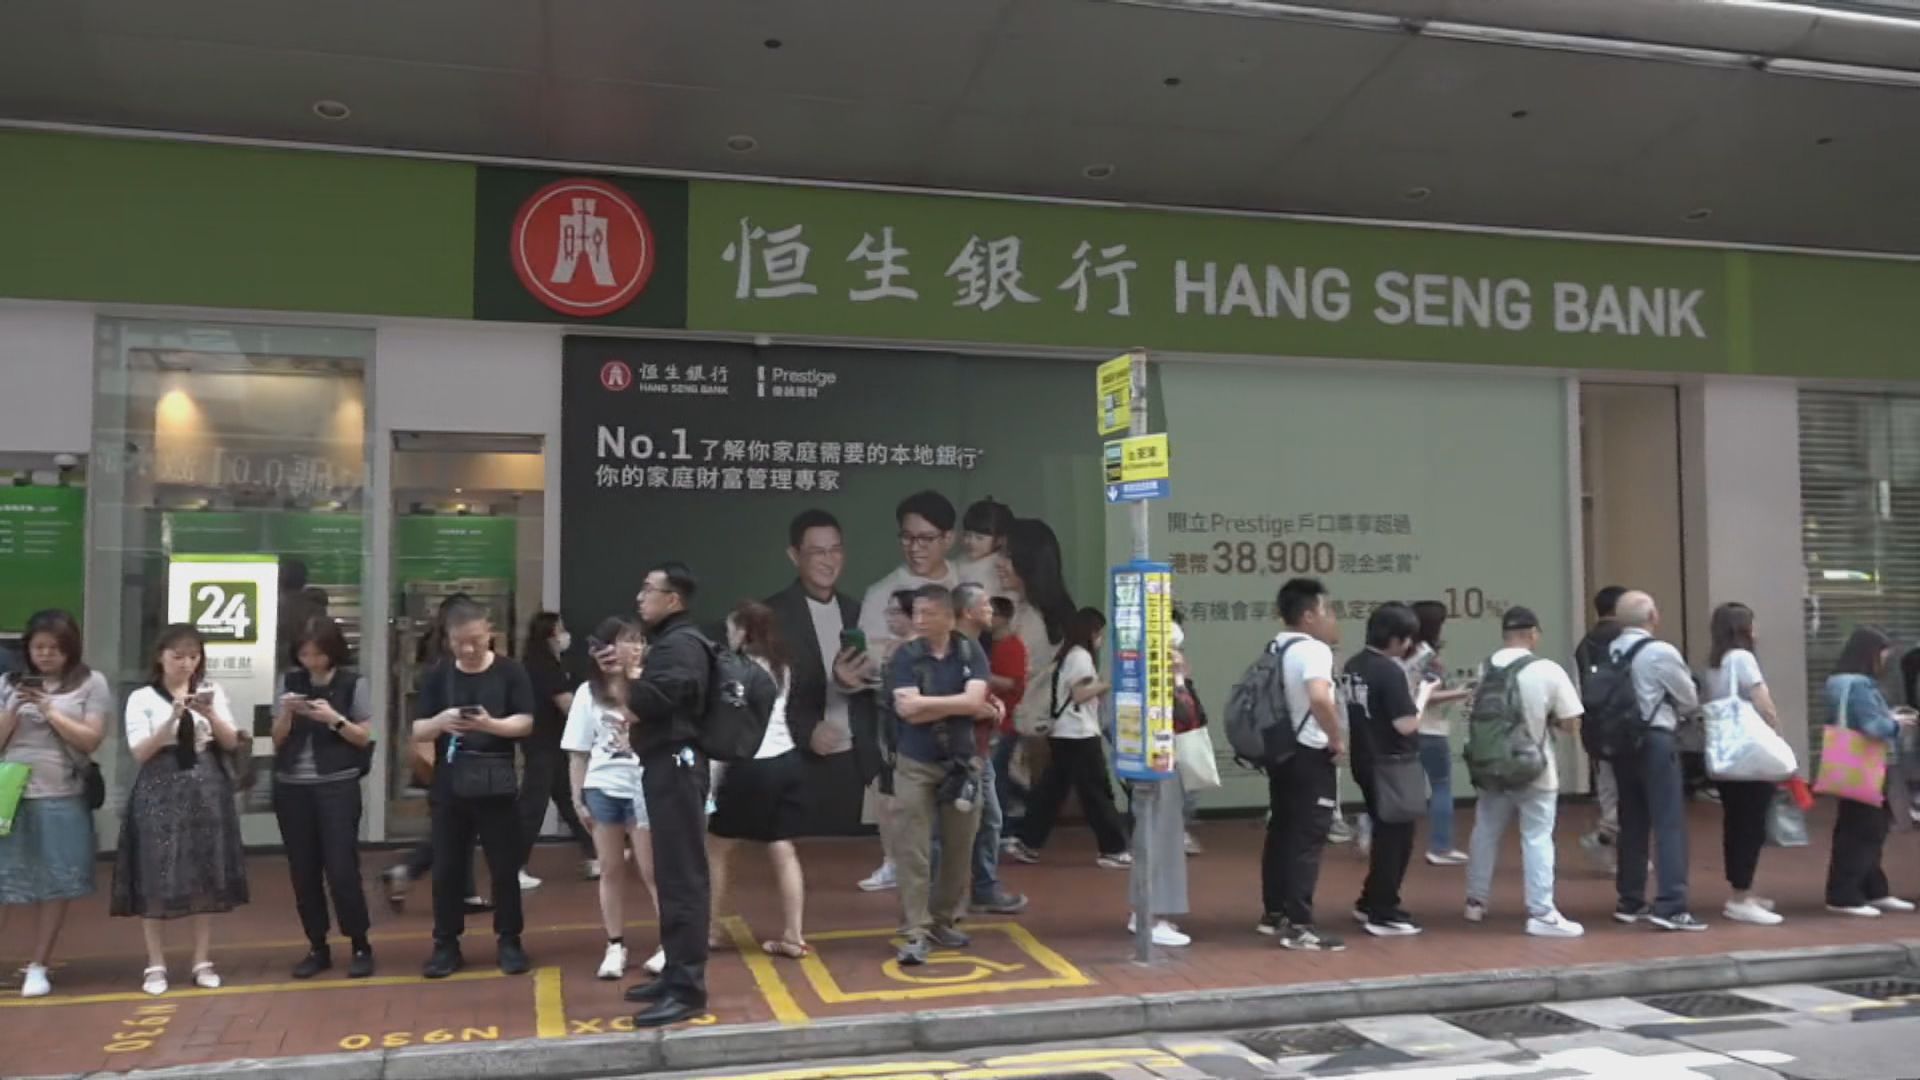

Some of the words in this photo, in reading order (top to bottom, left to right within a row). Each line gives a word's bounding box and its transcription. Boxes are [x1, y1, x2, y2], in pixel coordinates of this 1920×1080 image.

[722, 215, 1138, 316] 恒生銀行
[1174, 259, 1352, 322] HANG
[1373, 270, 1532, 331] SENG
[1553, 280, 1707, 339] BANK
[639, 383, 669, 393] HANG
[671, 384, 699, 394] SENG
[700, 384, 729, 395] BANK
[771, 367, 837, 387] Prestige
[597, 425, 693, 460] No.1
[595, 465, 840, 491] 你的家庭財富管理專家
[1212, 541, 1335, 575] 38,900
[196, 584, 251, 639] 24
